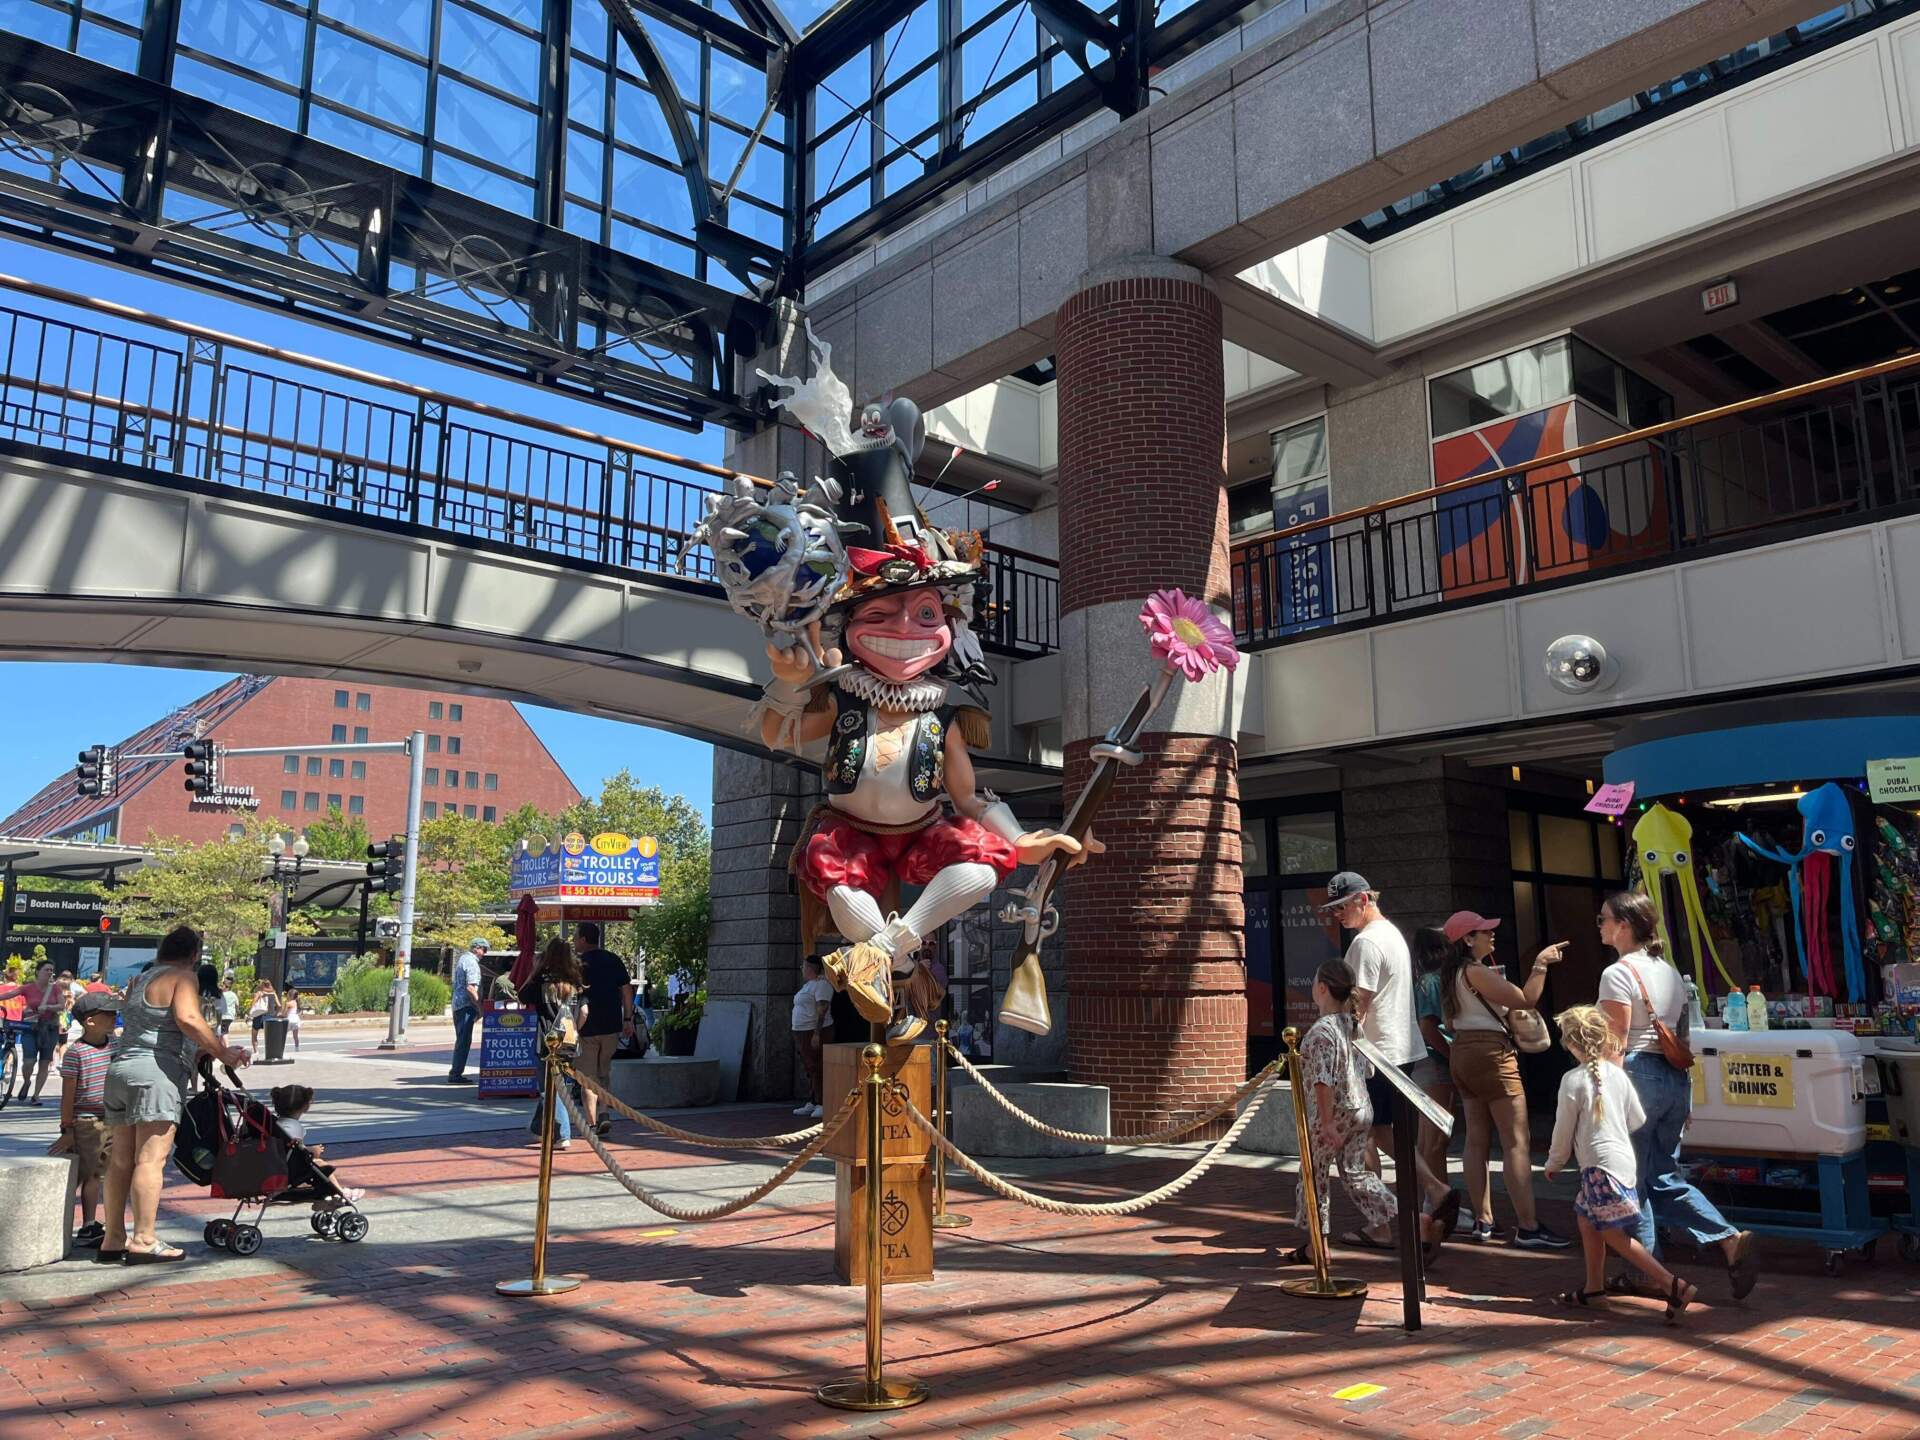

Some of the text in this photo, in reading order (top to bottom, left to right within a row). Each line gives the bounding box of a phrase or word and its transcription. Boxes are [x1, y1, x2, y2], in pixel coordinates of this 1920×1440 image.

[1708, 287, 1729, 306] EXIT
[1886, 777, 1909, 786] DUBAI
[224, 797, 262, 807] WHARF
[521, 856, 550, 872] TROLLEY
[582, 856, 640, 870] TROLLEY
[523, 872, 547, 886] TOURS
[588, 871, 634, 885] TOURS
[574, 887, 585, 896] 50
[588, 887, 616, 896] STOPS
[30, 899, 59, 909] Boston
[61, 901, 91, 910] Harbor
[24, 936, 49, 944] Harbor
[51, 936, 74, 944] Islands
[485, 1038, 534, 1049] TROLLEY
[490, 1049, 529, 1059] TOURS
[1727, 1062, 1784, 1078] WATER &
[1728, 1080, 1777, 1096] DRINKS
